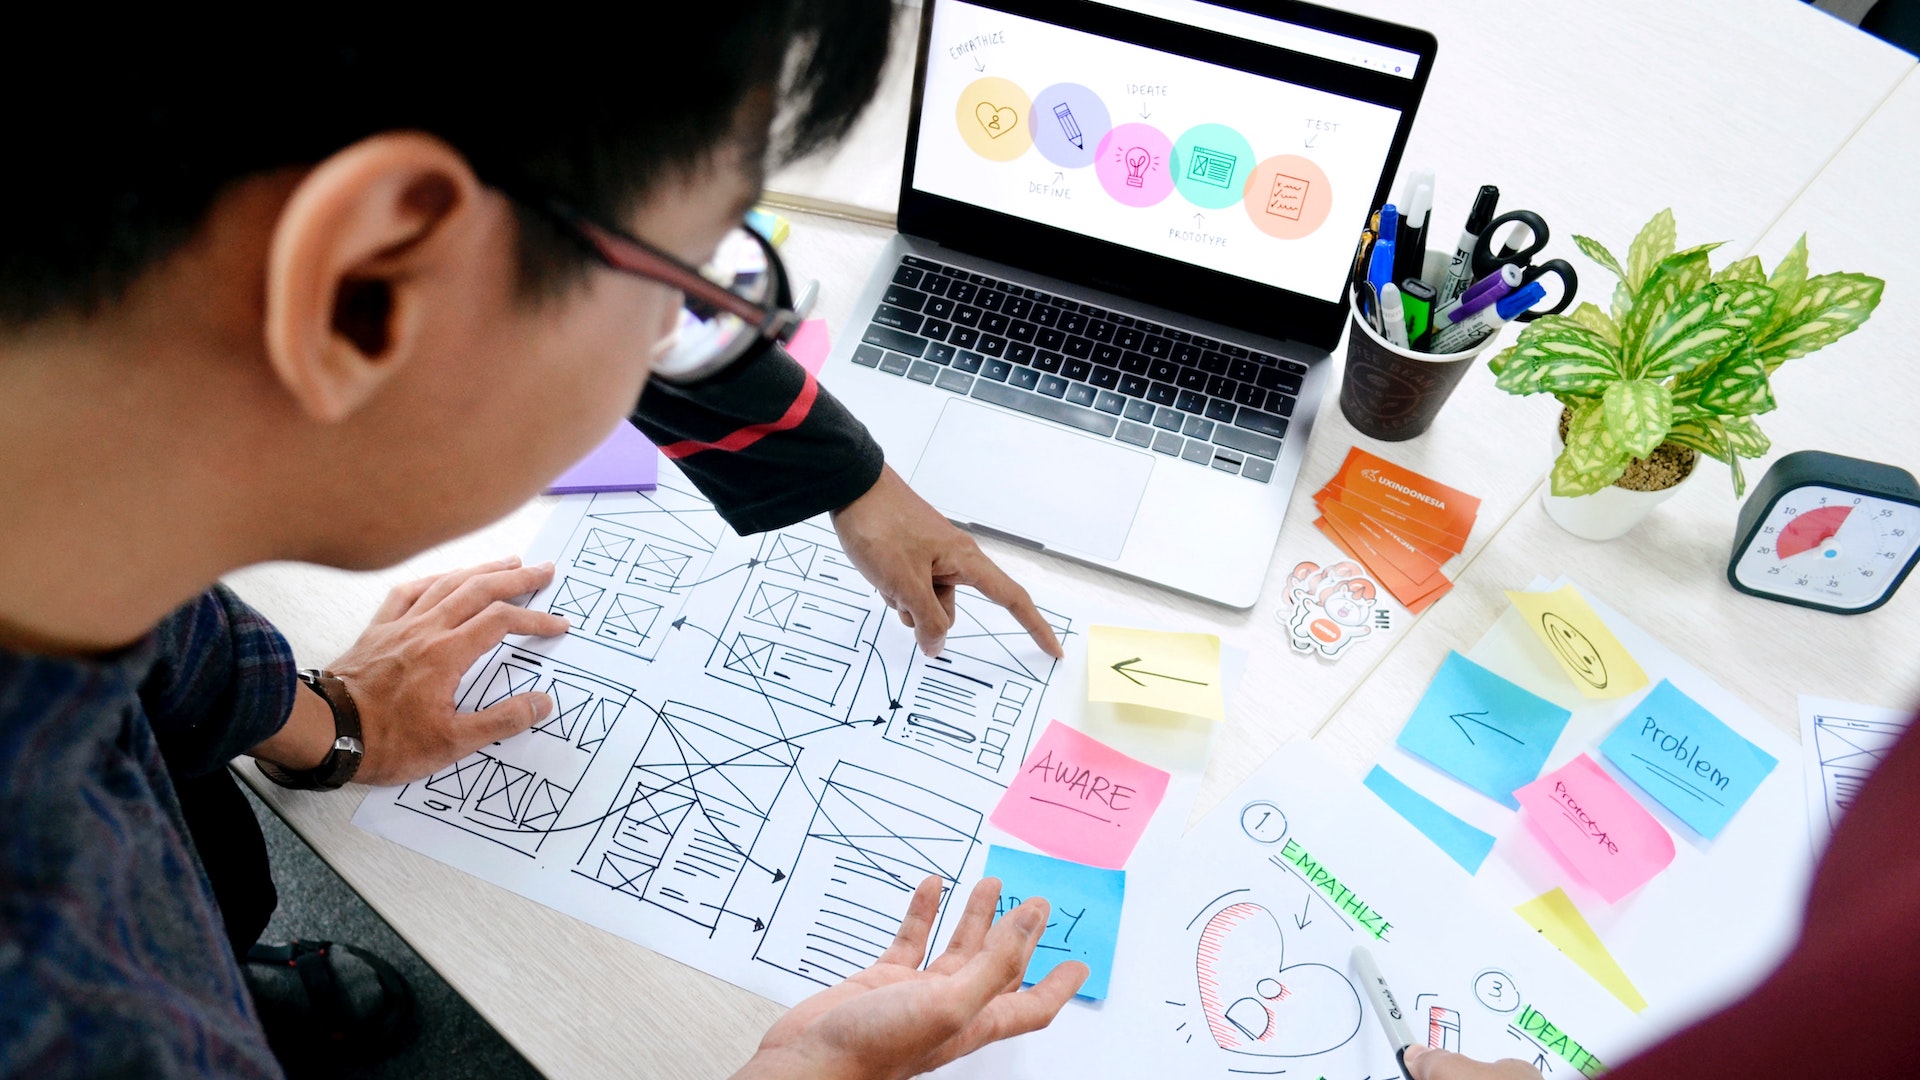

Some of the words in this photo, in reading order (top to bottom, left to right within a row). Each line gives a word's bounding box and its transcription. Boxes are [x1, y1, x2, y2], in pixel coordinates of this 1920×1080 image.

[950, 30, 1006, 60] EMPATHIZE
[1126, 84, 1168, 96] IDEATE
[1304, 118, 1341, 132] TEST
[1029, 181, 1072, 200] DEFINE
[1168, 228, 1228, 247] PROTOTYPE
[936, 349, 944, 358] Z
[964, 357, 972, 365] X
[992, 366, 1000, 374] C
[1022, 374, 1029, 382] V
[1049, 382, 1057, 390] B
[1077, 391, 1086, 399] N
[1105, 399, 1115, 407] M
[1378, 476, 1446, 510] UXINDONESIA
[1784, 507, 1796, 515] 10
[1881, 509, 1894, 518] 55
[1892, 529, 1905, 537] 50
[1768, 567, 1780, 575] 25
[1826, 580, 1839, 588] 35
[1375, 610, 1390, 628] HI!
[1641, 716, 1730, 791] Problem
[1028, 750, 1137, 811] AWARE
[1554, 781, 1619, 856] Prototype
[1280, 838, 1394, 943] EMPATHIZE
[1519, 1004, 1601, 1080] IDEATE
